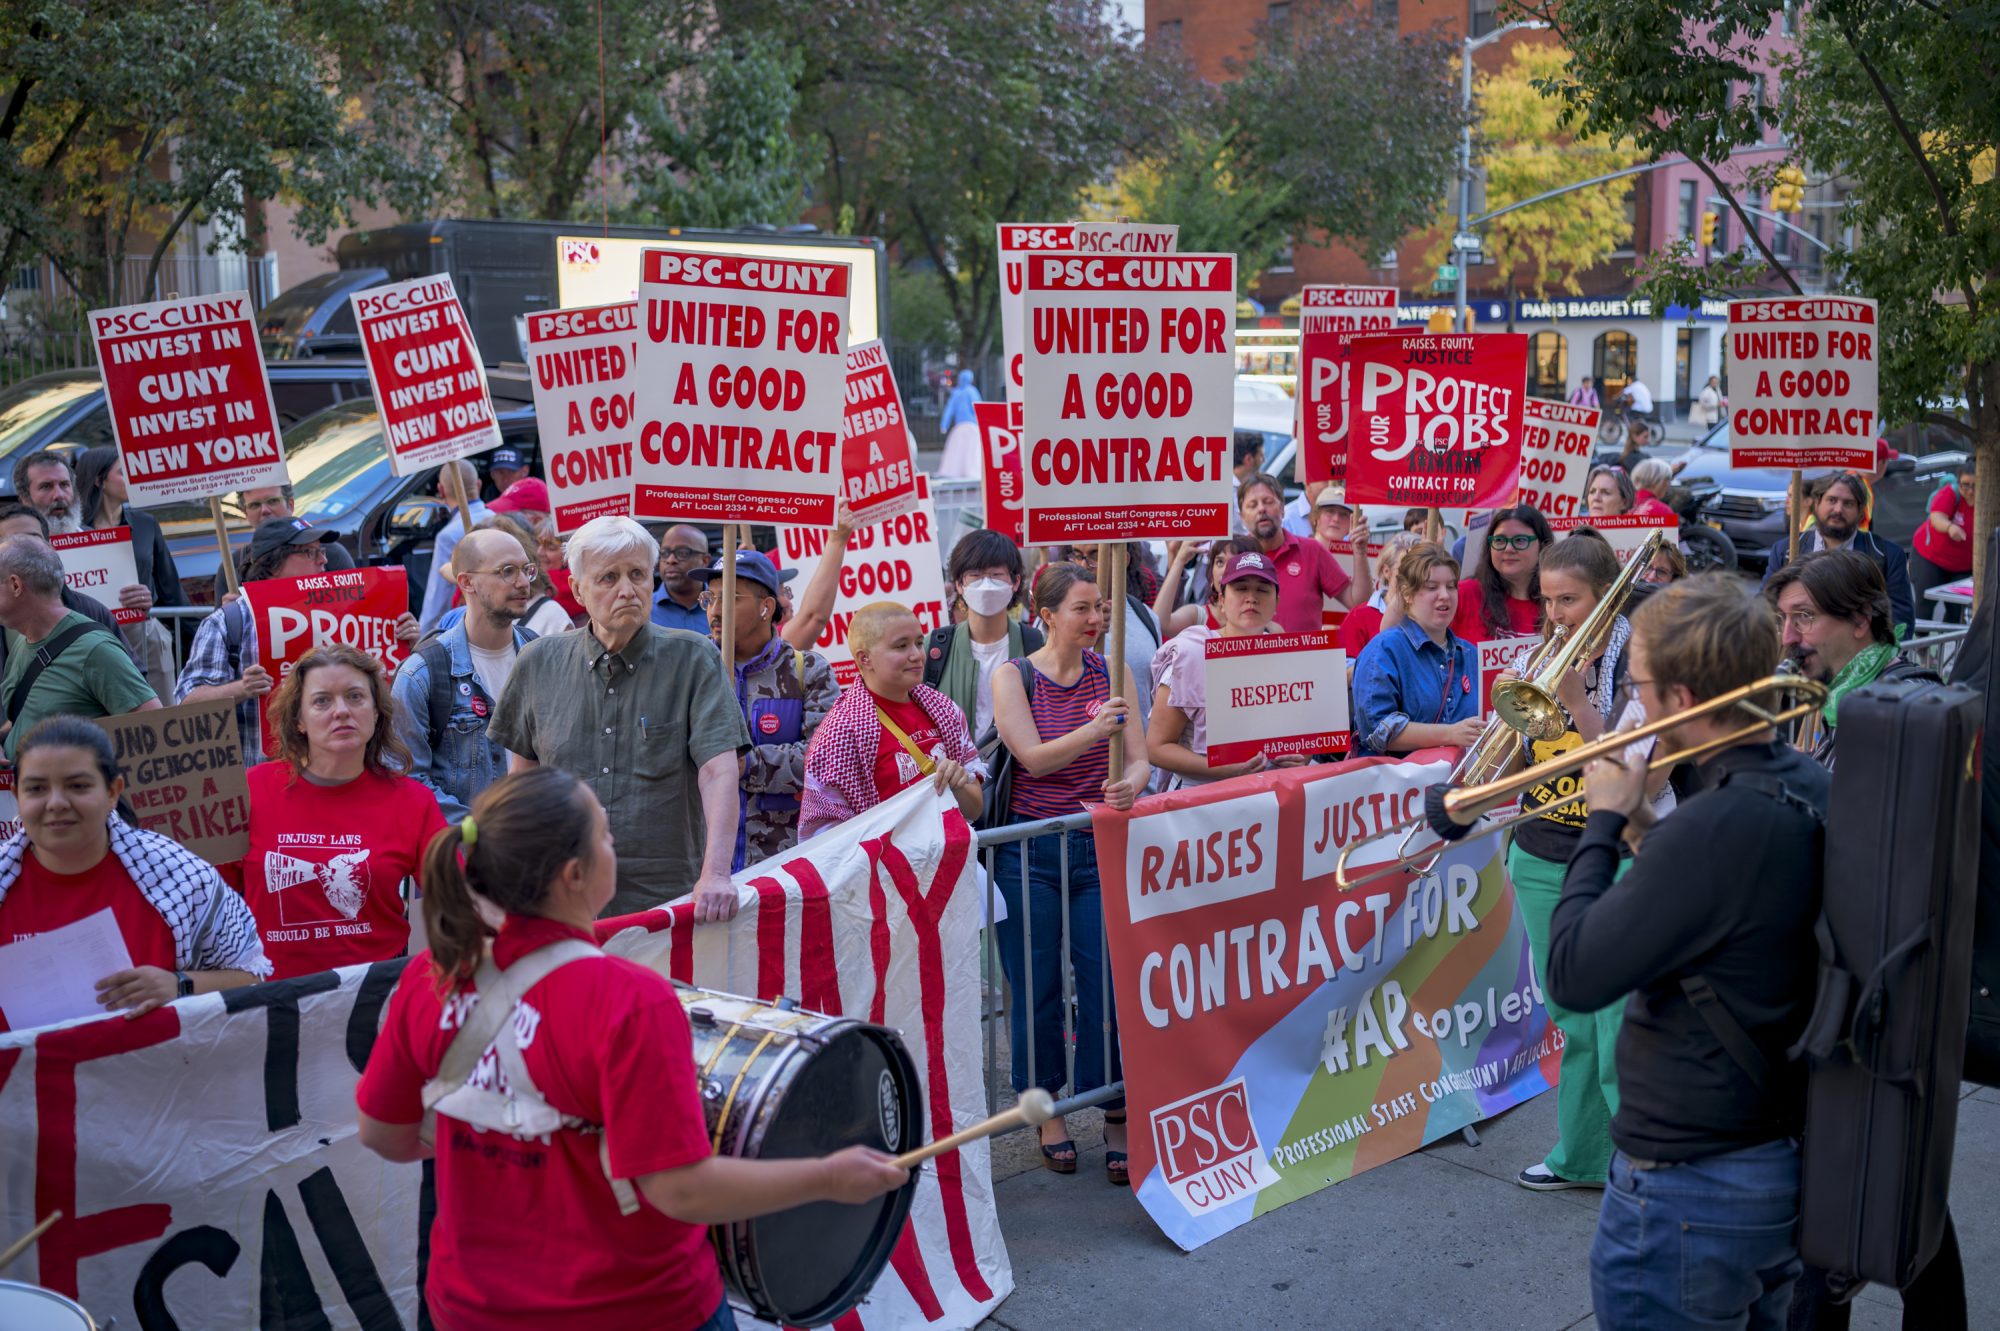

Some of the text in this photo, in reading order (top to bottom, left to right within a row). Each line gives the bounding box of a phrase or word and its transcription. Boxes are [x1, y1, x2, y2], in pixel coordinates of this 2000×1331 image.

[563, 241, 600, 263] PSC
[1011, 229, 1075, 249] PSC-
[660, 255, 834, 292] PSC-CUNY
[1043, 259, 1218, 287] PSC-CUNY
[1308, 290, 1389, 306] PSC-CUNY
[1521, 300, 1650, 318] PARIS BAGUETTE
[1741, 302, 1864, 321] PSC-CUNY
[96, 299, 243, 336] PSC-CUNY
[370, 303, 461, 343] INVEST IN
[538, 306, 638, 339] PSC-CU
[647, 299, 840, 354] UNITED FOR
[1033, 307, 1226, 355] UNITED FOR
[111, 327, 242, 365] INVEST IN
[394, 338, 460, 378] CUNY
[1402, 337, 1474, 350] RAISES, EQUITY,
[1403, 350, 1473, 365] JUSTICE
[1734, 330, 1872, 361] UNITED FOR
[536, 345, 626, 391] UNITED
[138, 364, 231, 404] CUNY
[389, 369, 479, 410] INVEST IN
[673, 362, 806, 412] A GOOD
[846, 373, 885, 404] UNY
[1061, 372, 1192, 420] A GOOD
[1361, 361, 1512, 415] PROTECT
[1755, 369, 1850, 398] A GOOD
[129, 400, 255, 438] INVEST IN
[390, 413, 438, 447] NEW
[441, 398, 494, 433] YORK
[568, 391, 635, 436] A GO
[844, 402, 899, 439] NEEDS
[1317, 403, 1331, 429] OUR
[1734, 408, 1873, 437] CONTRACT
[1370, 415, 1390, 445] OUR
[1370, 414, 1510, 461] JOBS
[1434, 438, 1448, 446] PSC
[1554, 430, 1590, 457] FOR
[126, 431, 276, 477] NEW YORK
[640, 420, 836, 474] CONTRACT
[869, 441, 884, 465] A
[1031, 436, 1227, 486] CONTRACT
[1804, 450, 1840, 458] Congress
[139, 465, 272, 492] Professional Staff Congress CUNY
[160, 488, 176, 497] AFT
[178, 485, 199, 494] Local
[224, 478, 240, 486] AFL
[242, 476, 256, 484] CIO
[848, 459, 911, 503] RAISE
[999, 471, 1014, 496] OUR
[1388, 476, 1475, 491] CONTRACT FOR
[562, 500, 609, 516] Professional
[600, 506, 618, 518] Local
[645, 489, 824, 507] Professional Staff Congress CUNY
[671, 501, 798, 515] AFT Local 2334 AFL CIO
[882, 511, 932, 547] FOR
[1038, 508, 1217, 521] Professional Staff Congress CUNY
[1064, 520, 1191, 532] AFT Local 2334 AFL CIO
[1593, 516, 1636, 527] Members
[1639, 516, 1664, 525] Want
[49, 530, 117, 547] embers Want
[296, 572, 365, 591] RAISES, EQUITY,
[840, 559, 912, 598] GOOD
[304, 585, 365, 605] JUSTICE
[268, 606, 399, 659] PROTECT
[1206, 634, 1329, 654] PSC/CUNY Members Want
[1231, 681, 1314, 708] RESPECT
[163, 709, 232, 747] CUNY,
[1264, 735, 1348, 754] #APeoplesCUNY
[137, 744, 243, 784] GENOCIDE.
[130, 777, 219, 810] NEED A
[278, 833, 362, 845] UNJUST LAWS
[1141, 786, 1430, 897] RAISES JUSTIC
[269, 853, 295, 869] CUNY
[271, 871, 305, 891] STRIKE
[266, 929, 309, 942] SHOULD
[315, 927, 330, 939] BE
[1140, 863, 1480, 1028] CONTRACT FOR
[1275, 1041, 1551, 1169] PROFESSIONAL STAFF AFT LOCAL
[1157, 1088, 1250, 1179] PSC
[1186, 1155, 1258, 1207] CUNY
